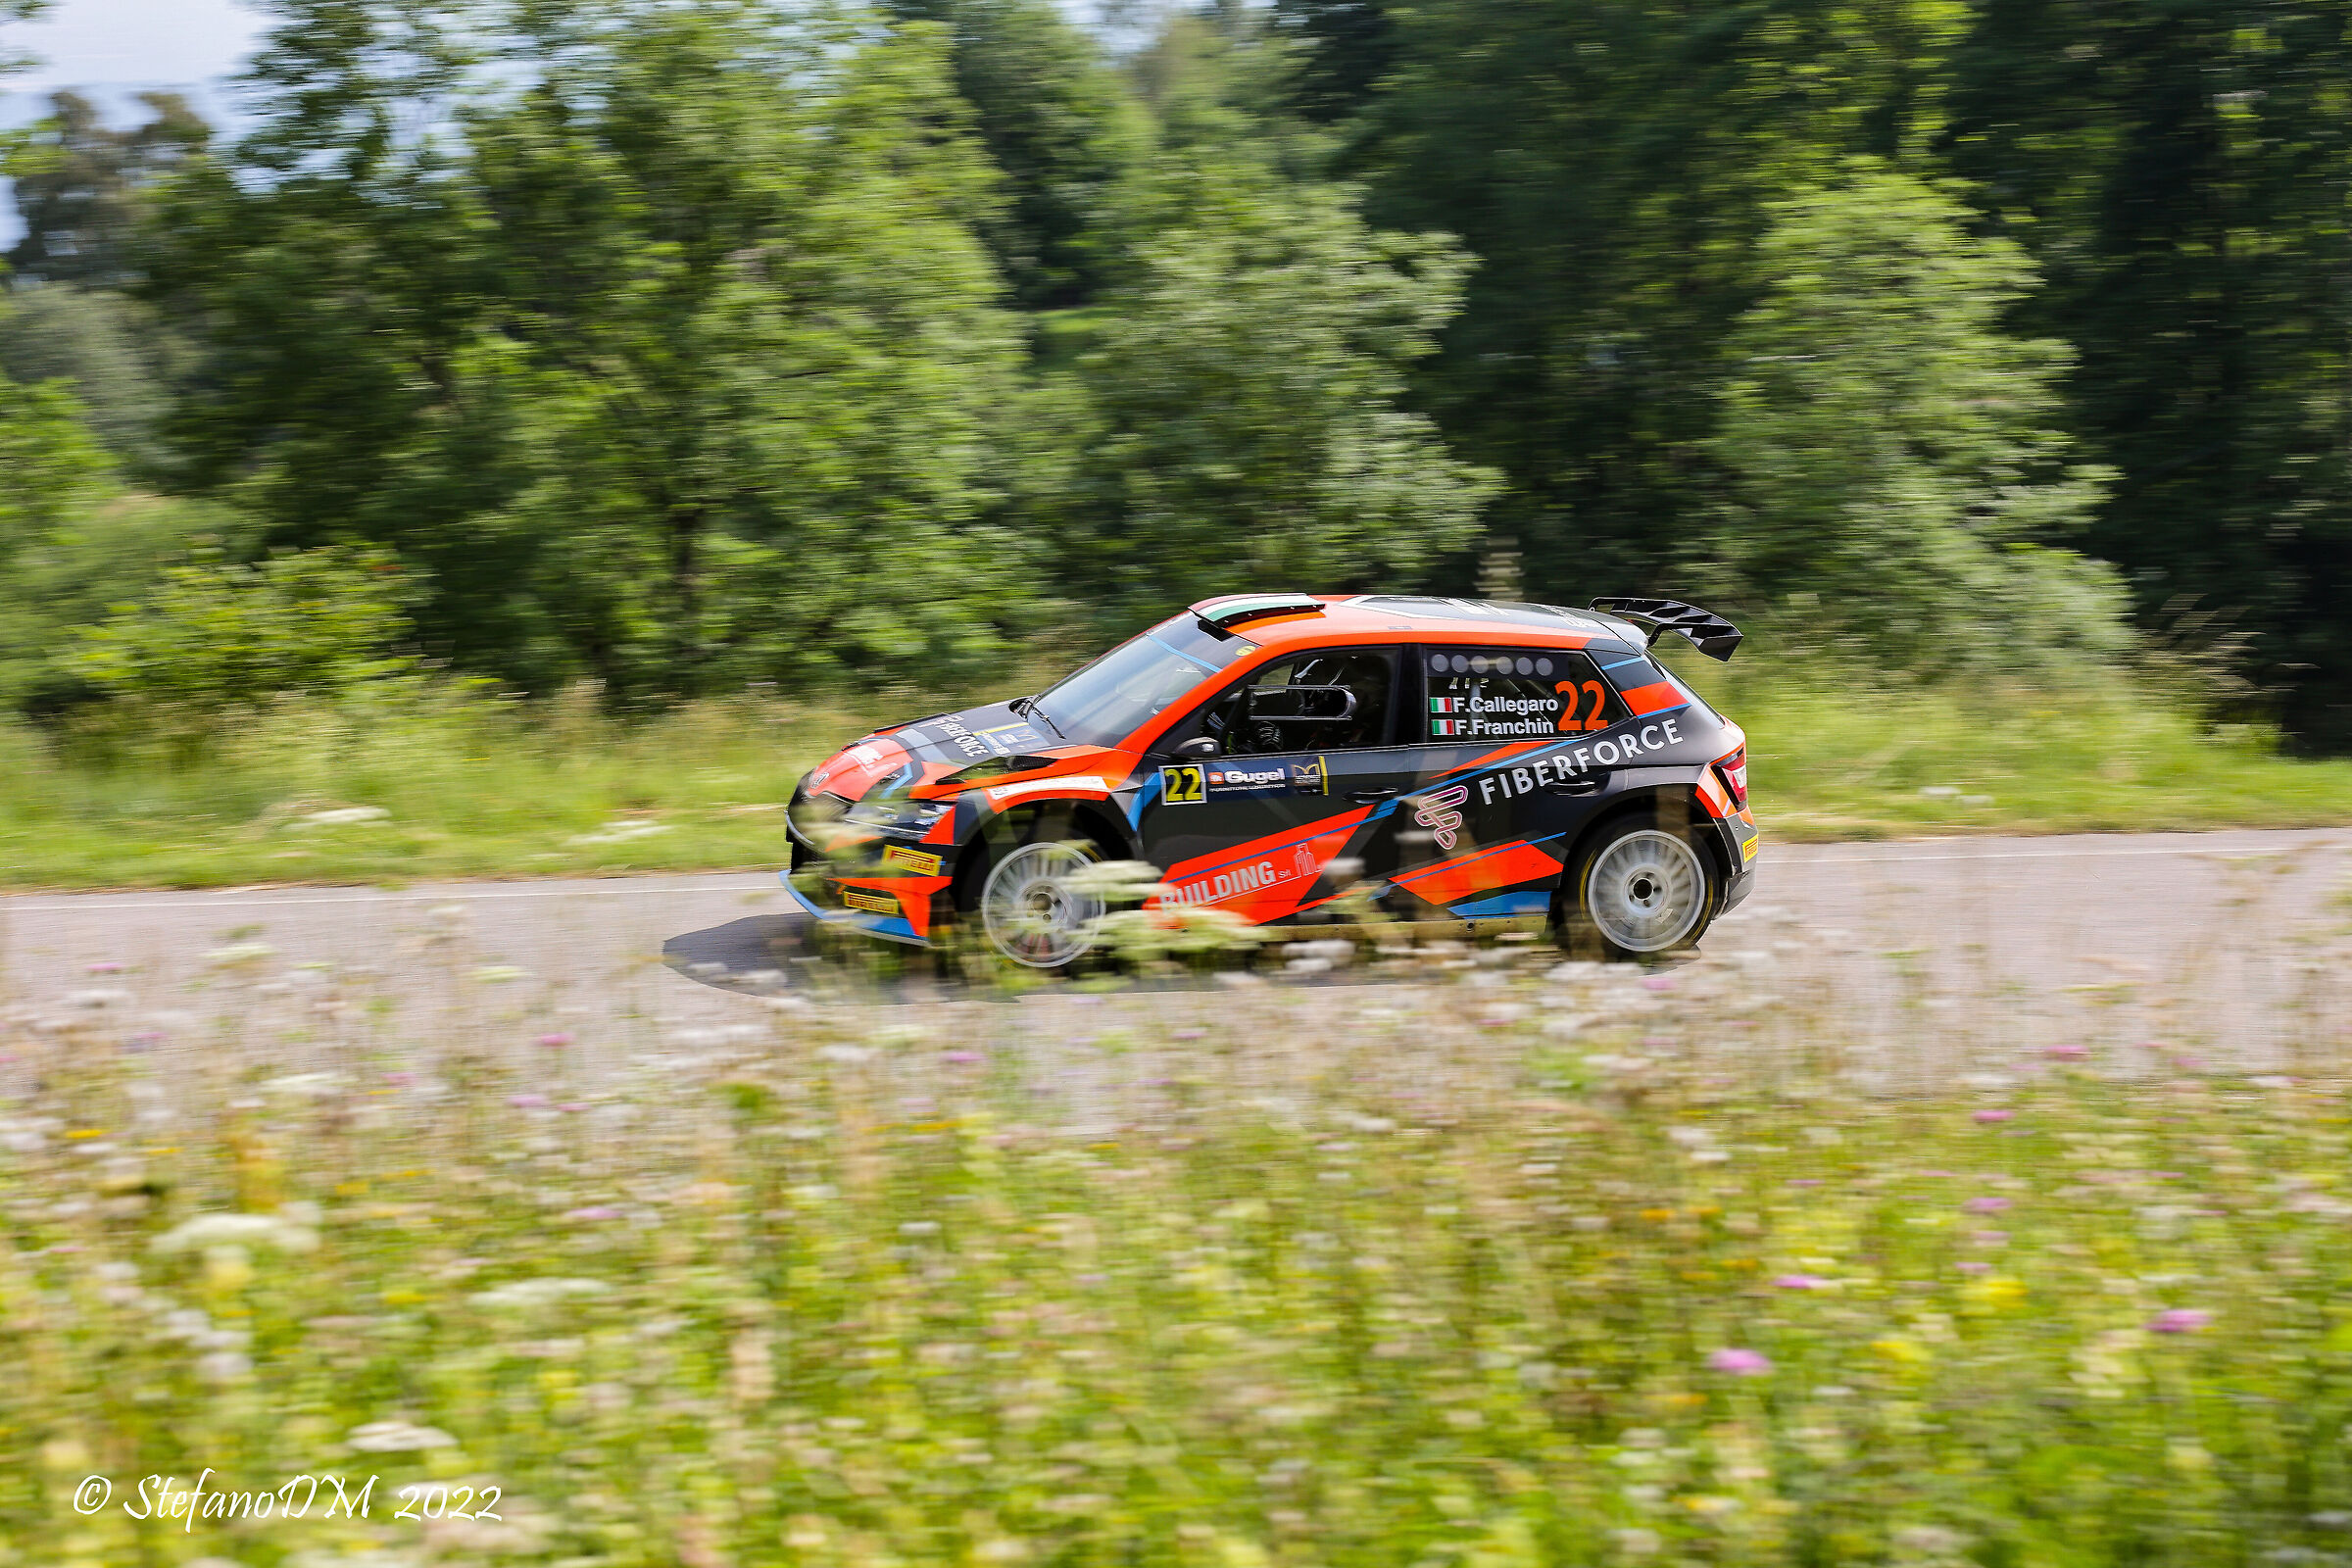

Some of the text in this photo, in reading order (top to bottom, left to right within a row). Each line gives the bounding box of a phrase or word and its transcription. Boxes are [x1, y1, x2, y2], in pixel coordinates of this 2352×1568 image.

[1452, 696, 1559, 720] F.Callegaro
[1554, 680, 1608, 731] 22
[1454, 717, 1554, 736] F.Franchin
[1224, 767, 1286, 785] Gugel
[1479, 718, 1684, 806] FIBERFORCE
[1164, 767, 1201, 802] 22
